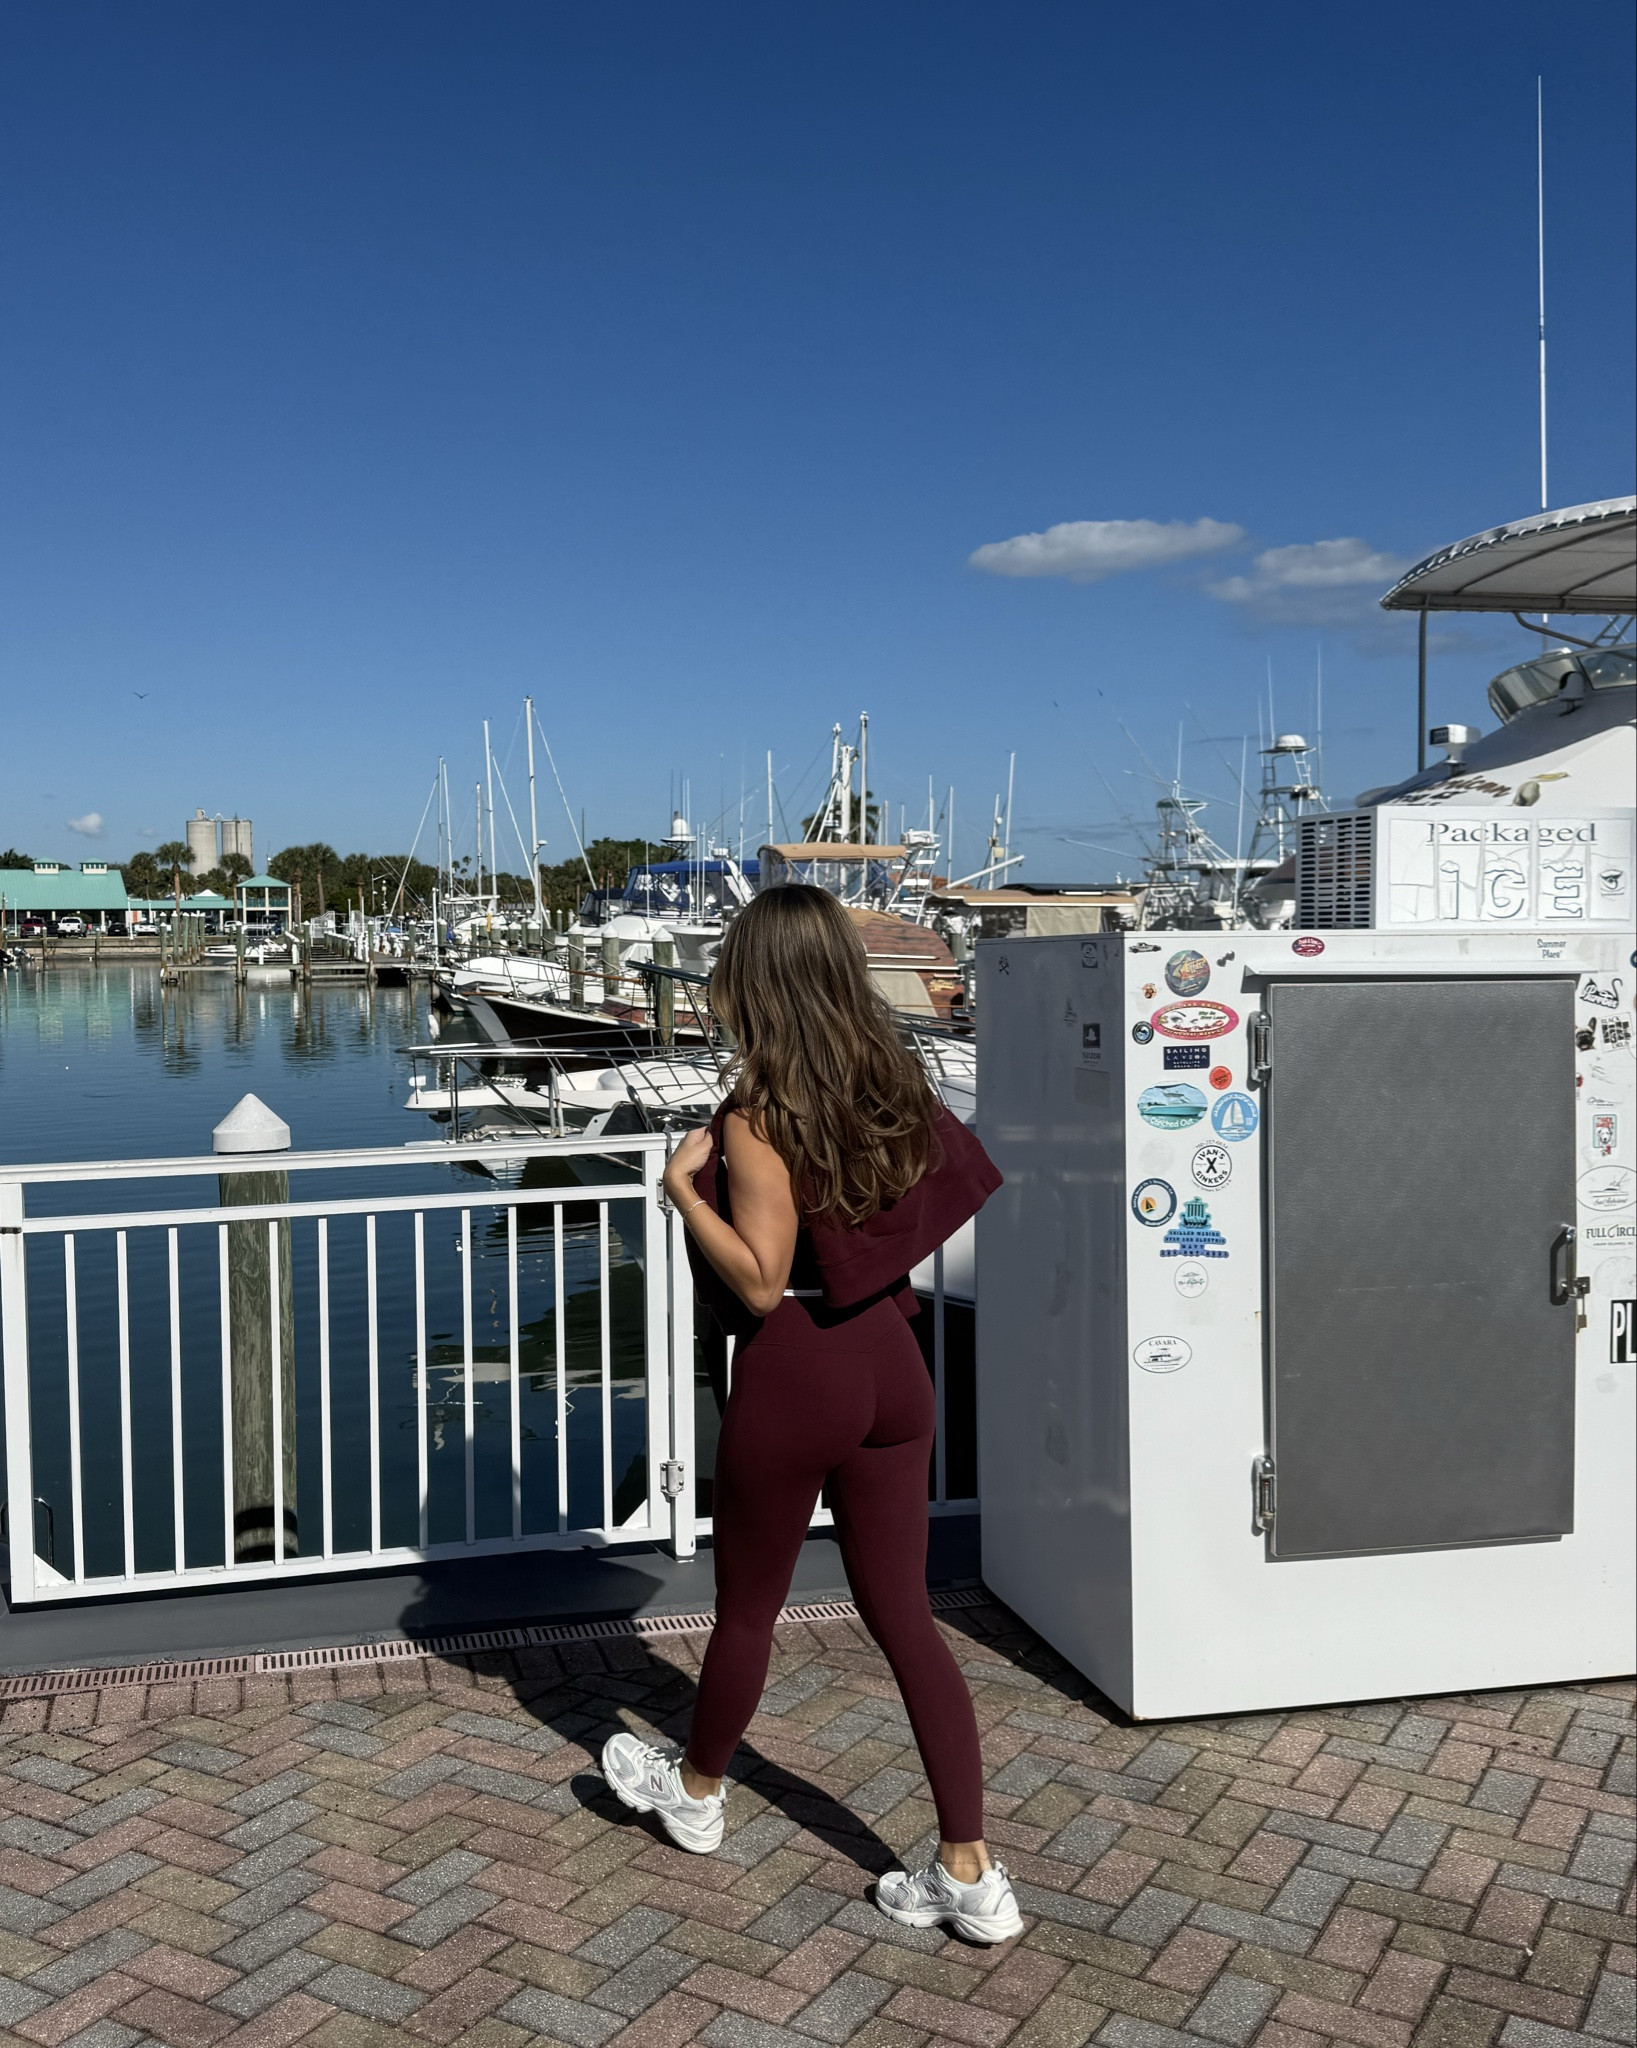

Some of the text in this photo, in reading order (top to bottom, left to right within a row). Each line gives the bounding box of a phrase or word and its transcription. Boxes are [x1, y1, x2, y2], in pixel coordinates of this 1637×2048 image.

[1426, 823, 1597, 847] Packaged
[1197, 1149, 1226, 1160] IVAN'S
[1195, 1170, 1228, 1184] SINKERS
[1586, 1227, 1607, 1239] FULL
[1148, 1339, 1178, 1347] CAVARA
